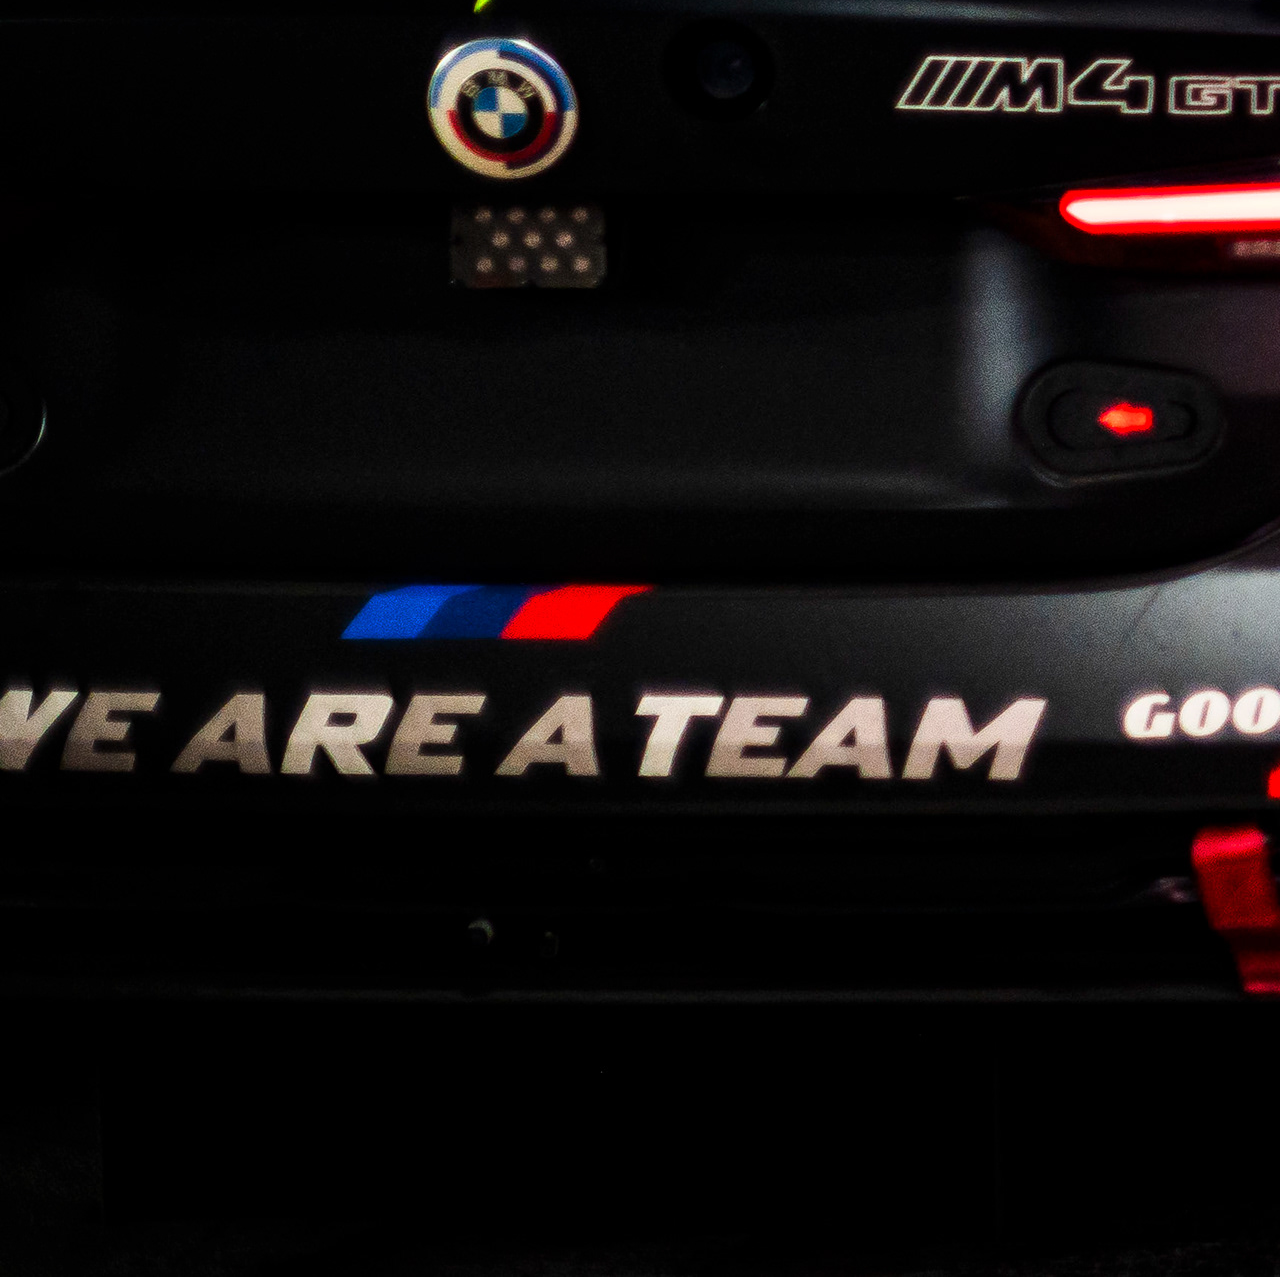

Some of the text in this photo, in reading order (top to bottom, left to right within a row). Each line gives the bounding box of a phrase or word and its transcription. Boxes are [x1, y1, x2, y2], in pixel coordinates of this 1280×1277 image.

[169, 693, 489, 776] ARE
[493, 695, 599, 777] A
[634, 695, 1049, 781] TEAM
